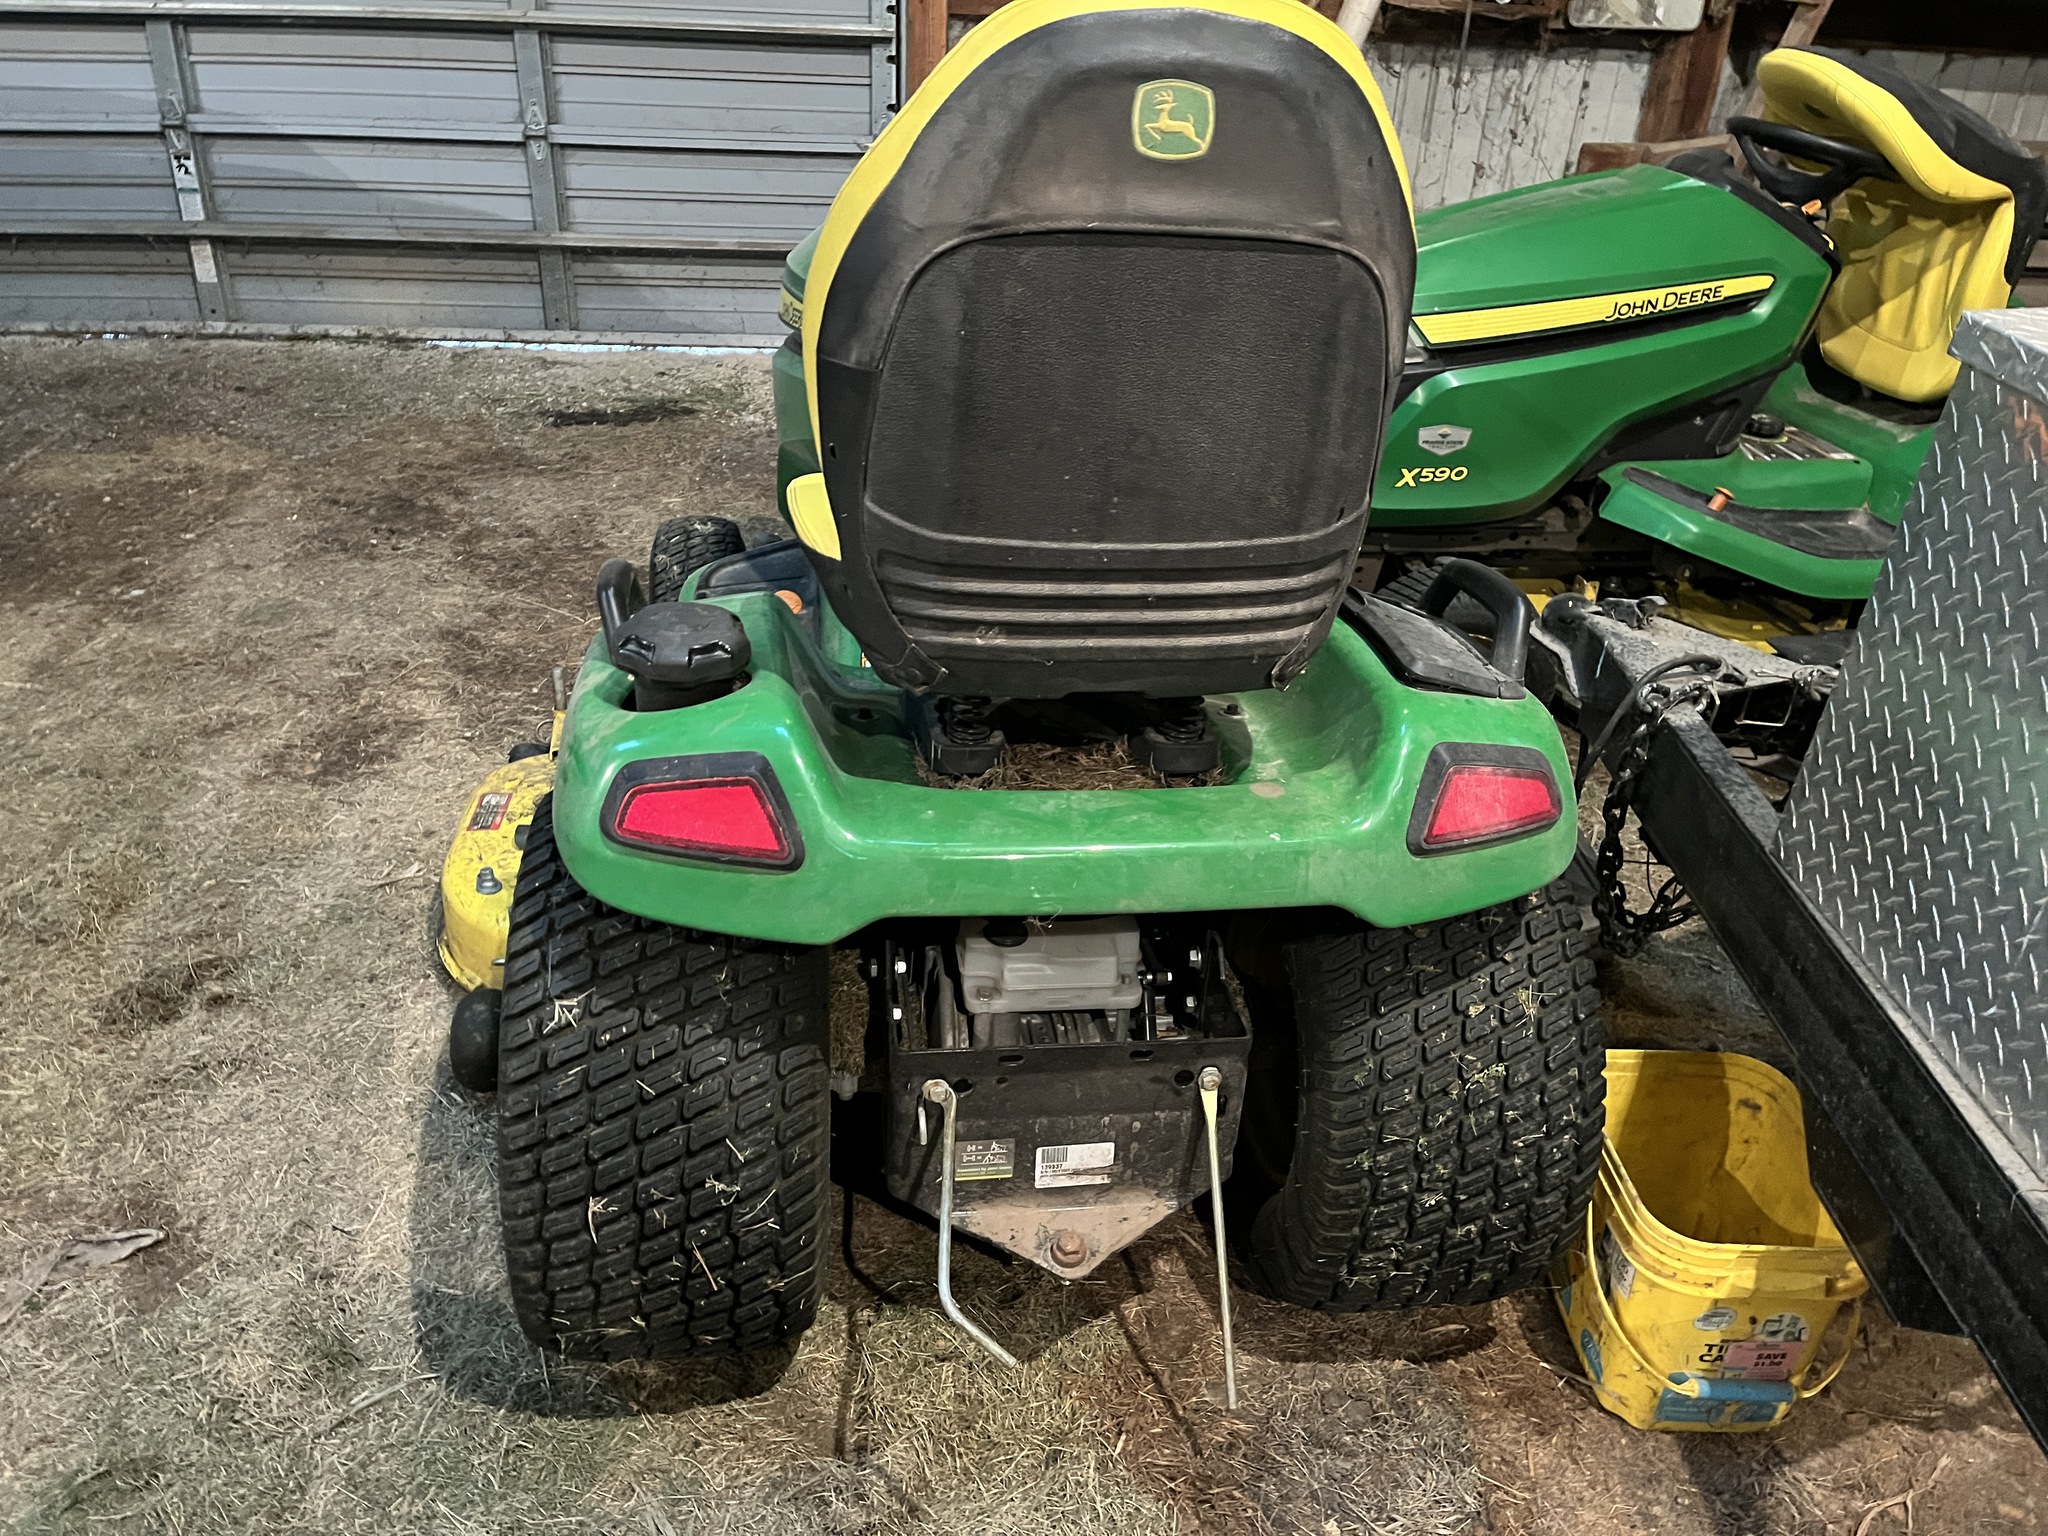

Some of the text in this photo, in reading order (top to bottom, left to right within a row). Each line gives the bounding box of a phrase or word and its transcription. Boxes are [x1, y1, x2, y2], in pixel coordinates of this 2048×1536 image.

[1605, 285, 1725, 319] JOHN DEERE
[1394, 466, 1469, 488] X590
[1755, 1352, 1788, 1361] SAVE
